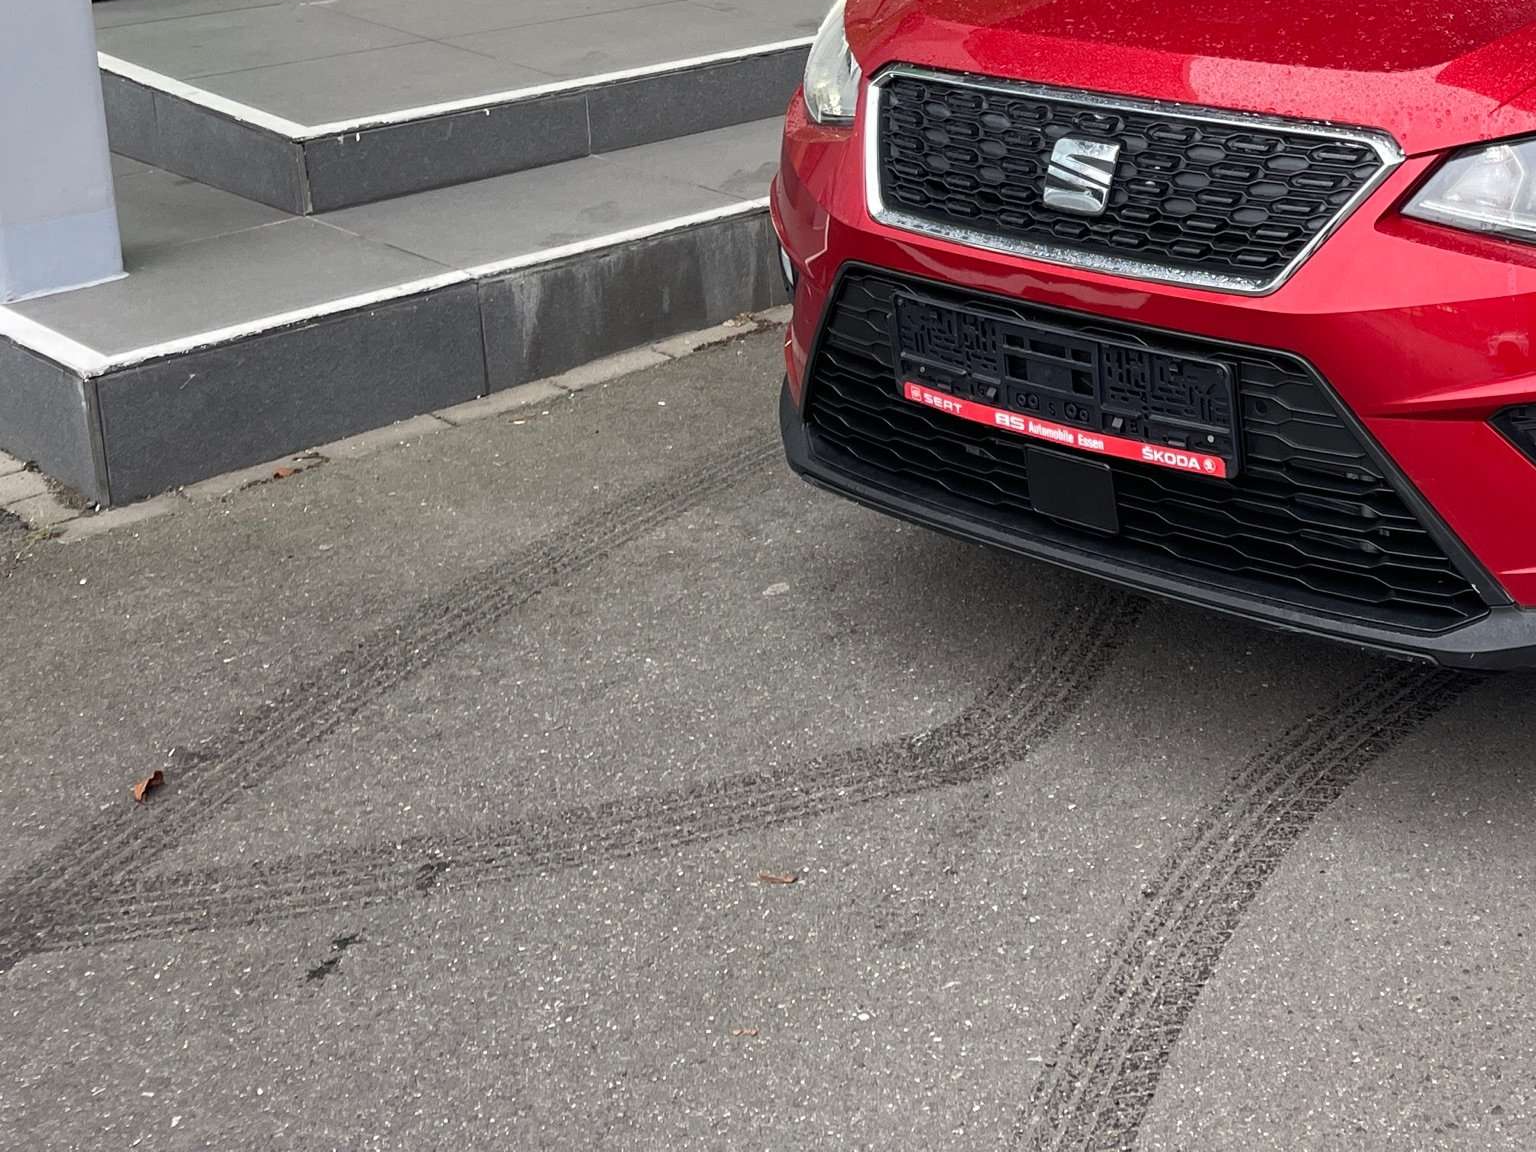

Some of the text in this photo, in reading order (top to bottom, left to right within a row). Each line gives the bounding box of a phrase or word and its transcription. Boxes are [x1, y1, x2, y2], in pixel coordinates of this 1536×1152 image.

[923, 392, 963, 415] SEAT
[1028, 421, 1075, 444] Automobile
[1077, 432, 1105, 451] Essen
[1141, 445, 1201, 470] ŠKODA
